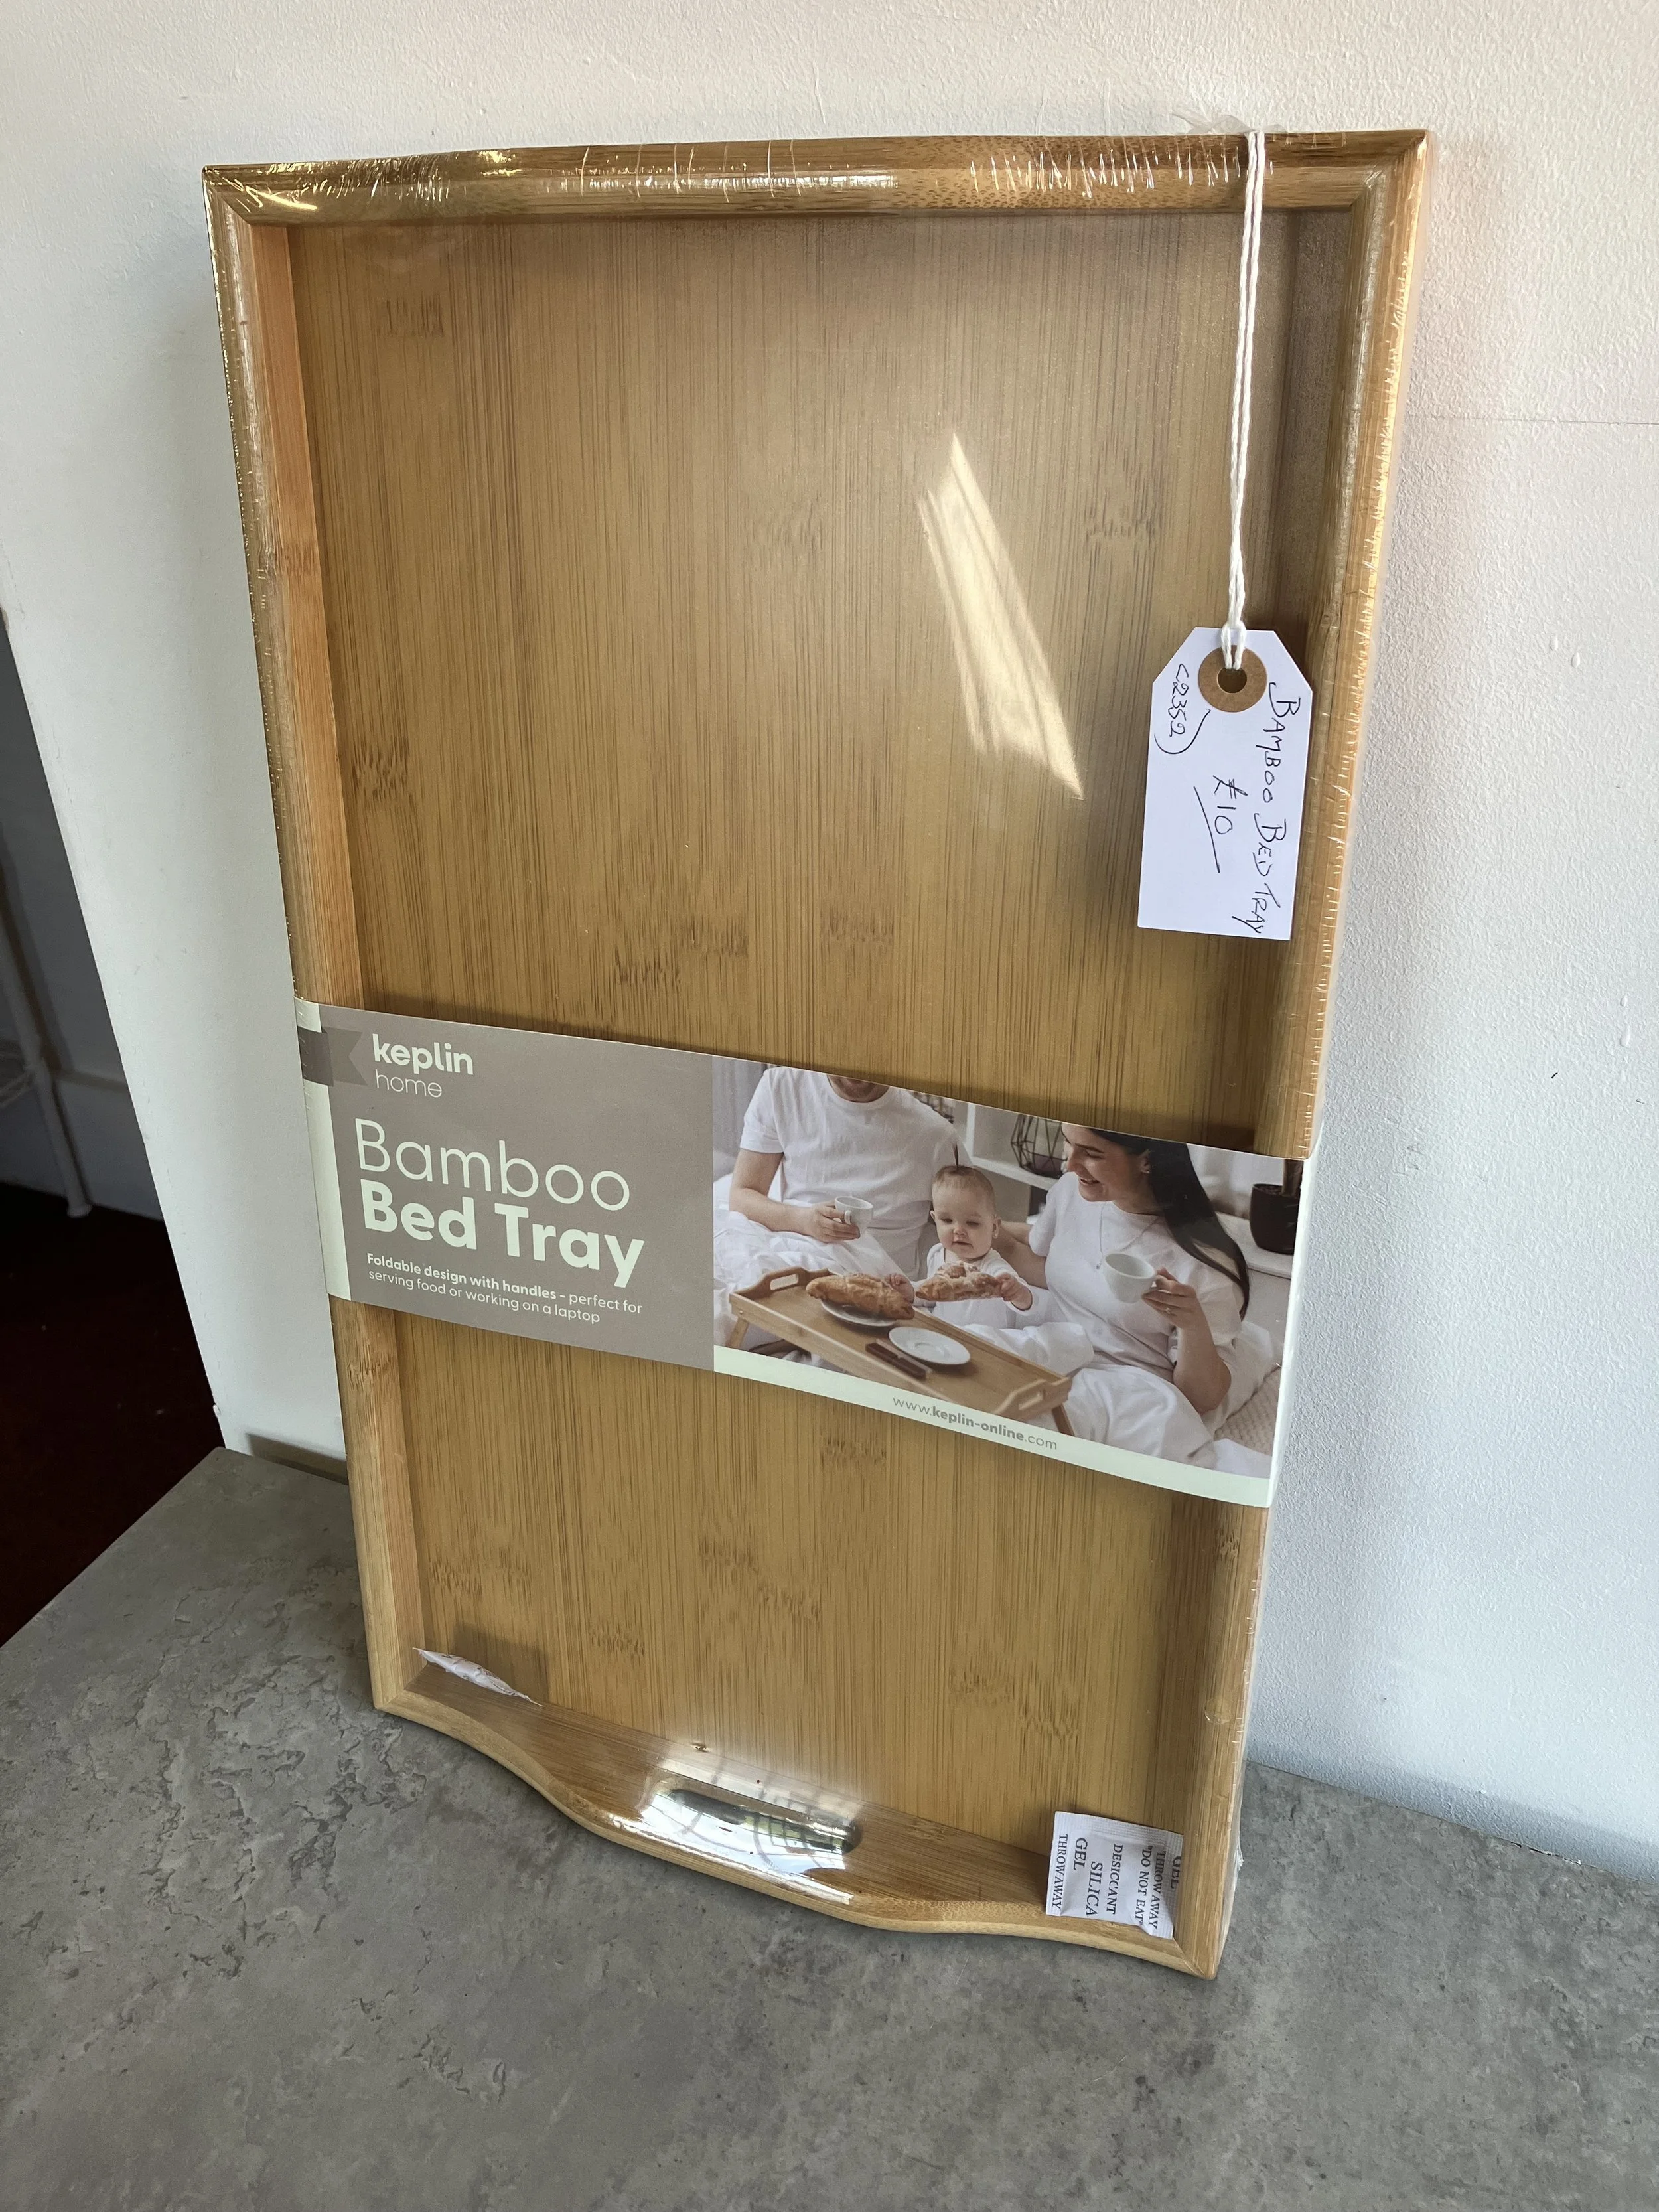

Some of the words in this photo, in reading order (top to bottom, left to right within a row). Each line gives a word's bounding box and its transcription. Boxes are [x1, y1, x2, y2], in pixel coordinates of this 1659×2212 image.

[1256, 682, 1301, 804] BAMBOO
[1212, 774, 1248, 836] £10
[1252, 813, 1287, 877] BED
[1231, 882, 1281, 934] TRAY
[371, 1033, 474, 1076] keplin
[375, 1069, 443, 1098] home
[354, 1117, 630, 1211] Bamboo
[360, 1178, 478, 1251] Bed
[494, 1202, 645, 1288] Tray
[366, 1252, 421, 1274] Foldable
[423, 1265, 467, 1285] design
[469, 1276, 500, 1290] with
[502, 1279, 557, 1300] handles
[569, 1293, 620, 1311] perfect
[622, 1299, 643, 1314] for
[368, 1270, 414, 1291] serving
[415, 1278, 447, 1295] food
[449, 1287, 463, 1298] or
[465, 1290, 520, 1311] working
[522, 1301, 540, 1312] on
[542, 1304, 551, 1315] a
[555, 1304, 601, 1325] laptop
[892, 1396, 1058, 1451] www.keplin-online.com
[1054, 1833, 1069, 1878] THROW
[1073, 1836, 1089, 1871] GEL
[1106, 1843, 1124, 1915] DESICCANT
[1151, 1849, 1167, 1894] THROW
[1051, 1876, 1064, 1911] AWAY
[1086, 1860, 1104, 1917] SILICA
[1137, 1870, 1150, 1897] NOT
[1148, 1894, 1161, 1930] AWAY
